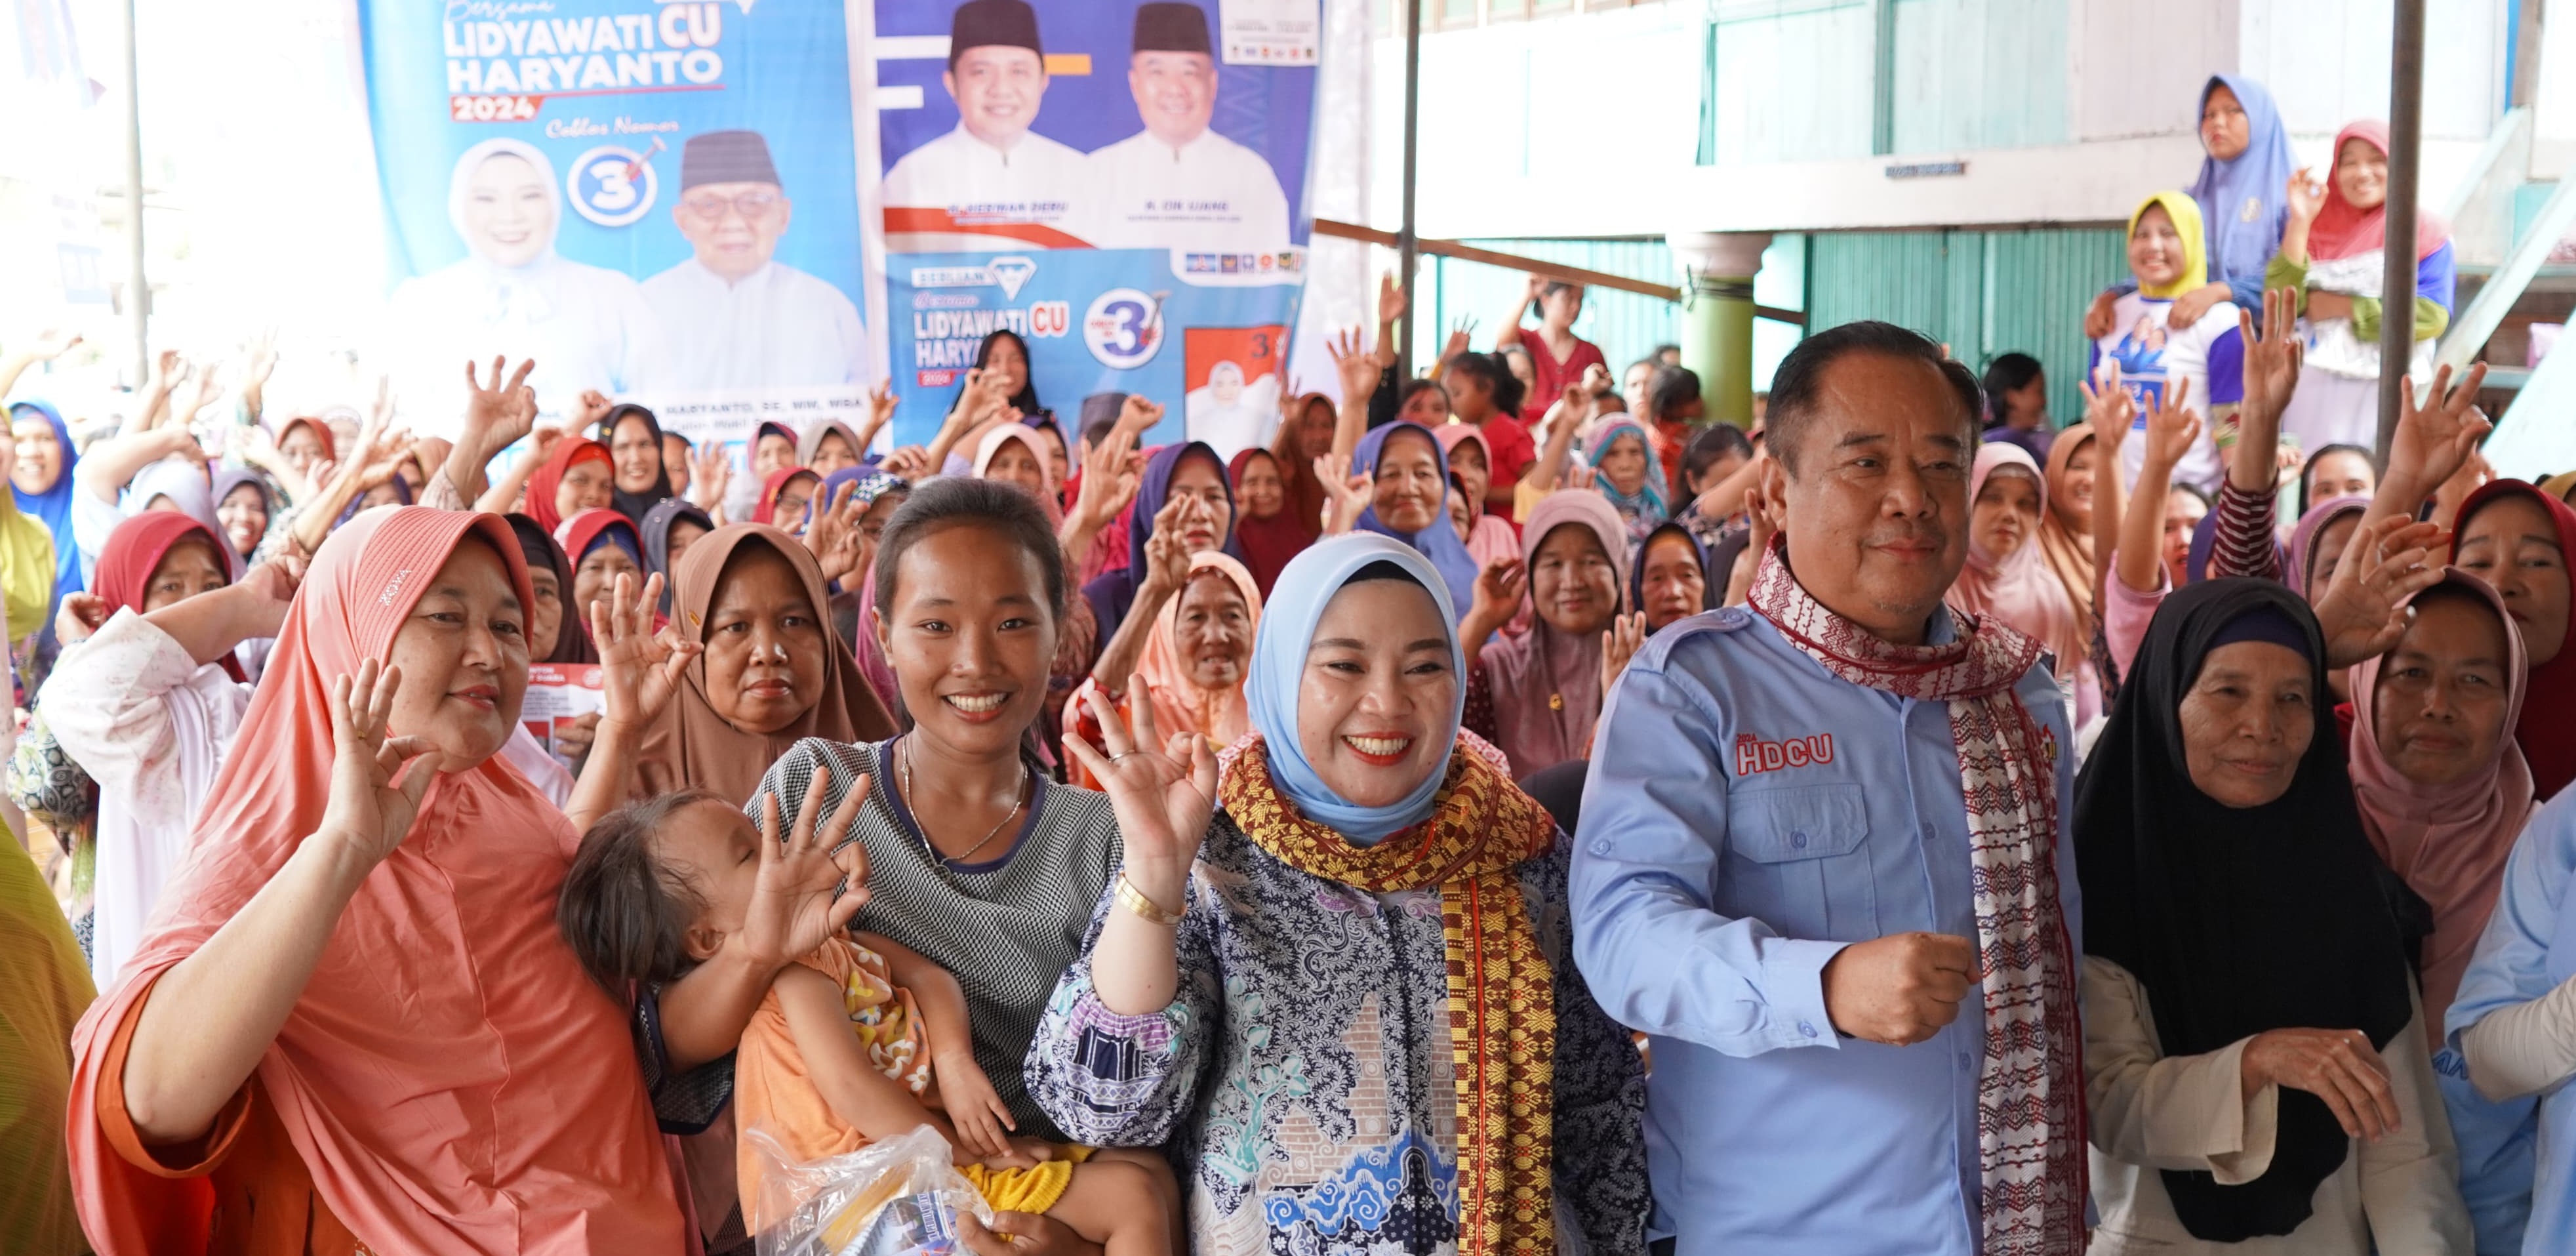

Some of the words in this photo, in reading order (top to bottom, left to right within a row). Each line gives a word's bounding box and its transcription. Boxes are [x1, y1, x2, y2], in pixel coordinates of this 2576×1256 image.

[443, 13, 654, 57] LIDYAWATI
[658, 2, 722, 49] CU
[447, 49, 723, 92] HARYANTO
[454, 96, 536, 121] 2024
[590, 159, 637, 210] 3
[914, 310, 1028, 339] LIDYAWATI
[1031, 302, 1069, 336] CU
[1103, 301, 1149, 357] 3
[1251, 334, 1270, 357] 3
[1736, 733, 1834, 776] HDCU
[1737, 733, 1758, 742] 2024
